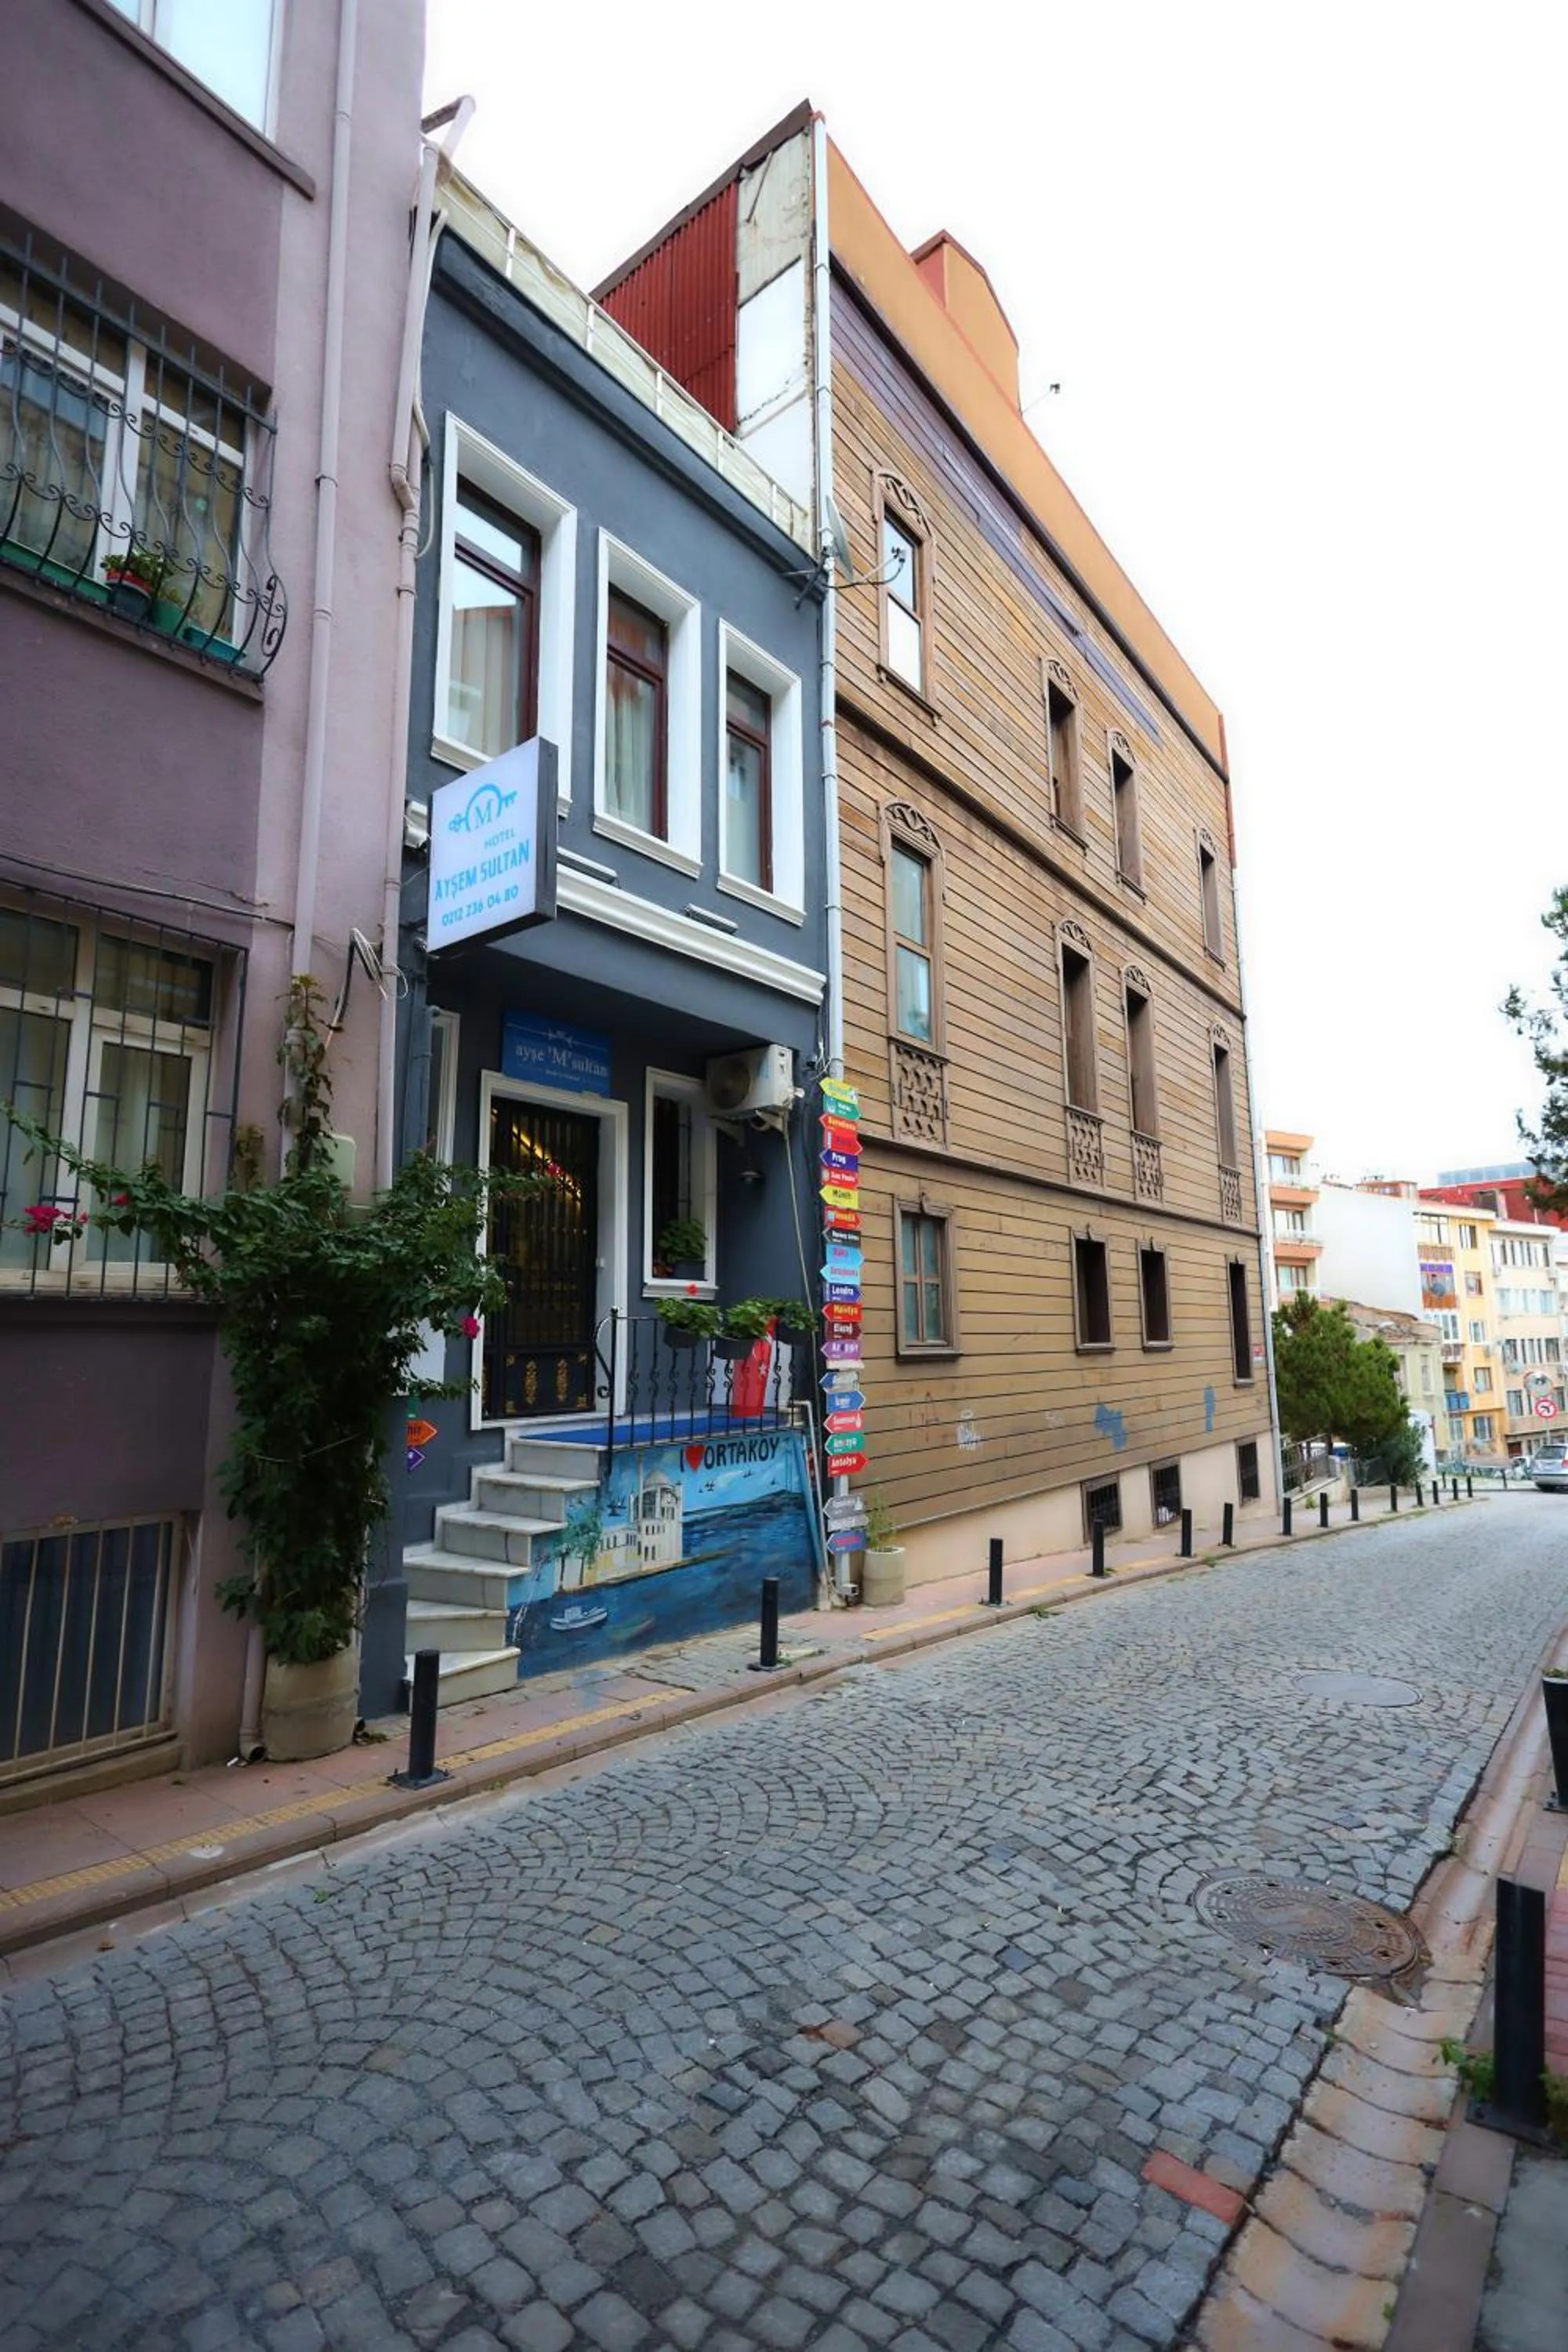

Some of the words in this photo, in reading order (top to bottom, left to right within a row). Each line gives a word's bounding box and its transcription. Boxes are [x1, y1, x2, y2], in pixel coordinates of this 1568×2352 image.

[484, 827, 515, 850] HOTEL
[434, 866, 477, 901] AYŞEM
[481, 840, 530, 882] SULTAN
[441, 906, 463, 927] 0212
[466, 898, 484, 917] 236
[487, 892, 501, 909] 04
[572, 1057, 608, 1078] sultan
[832, 1152, 847, 1165] Prag
[832, 1285, 854, 1296] Londra
[704, 1436, 779, 1470] ORTAKOY
